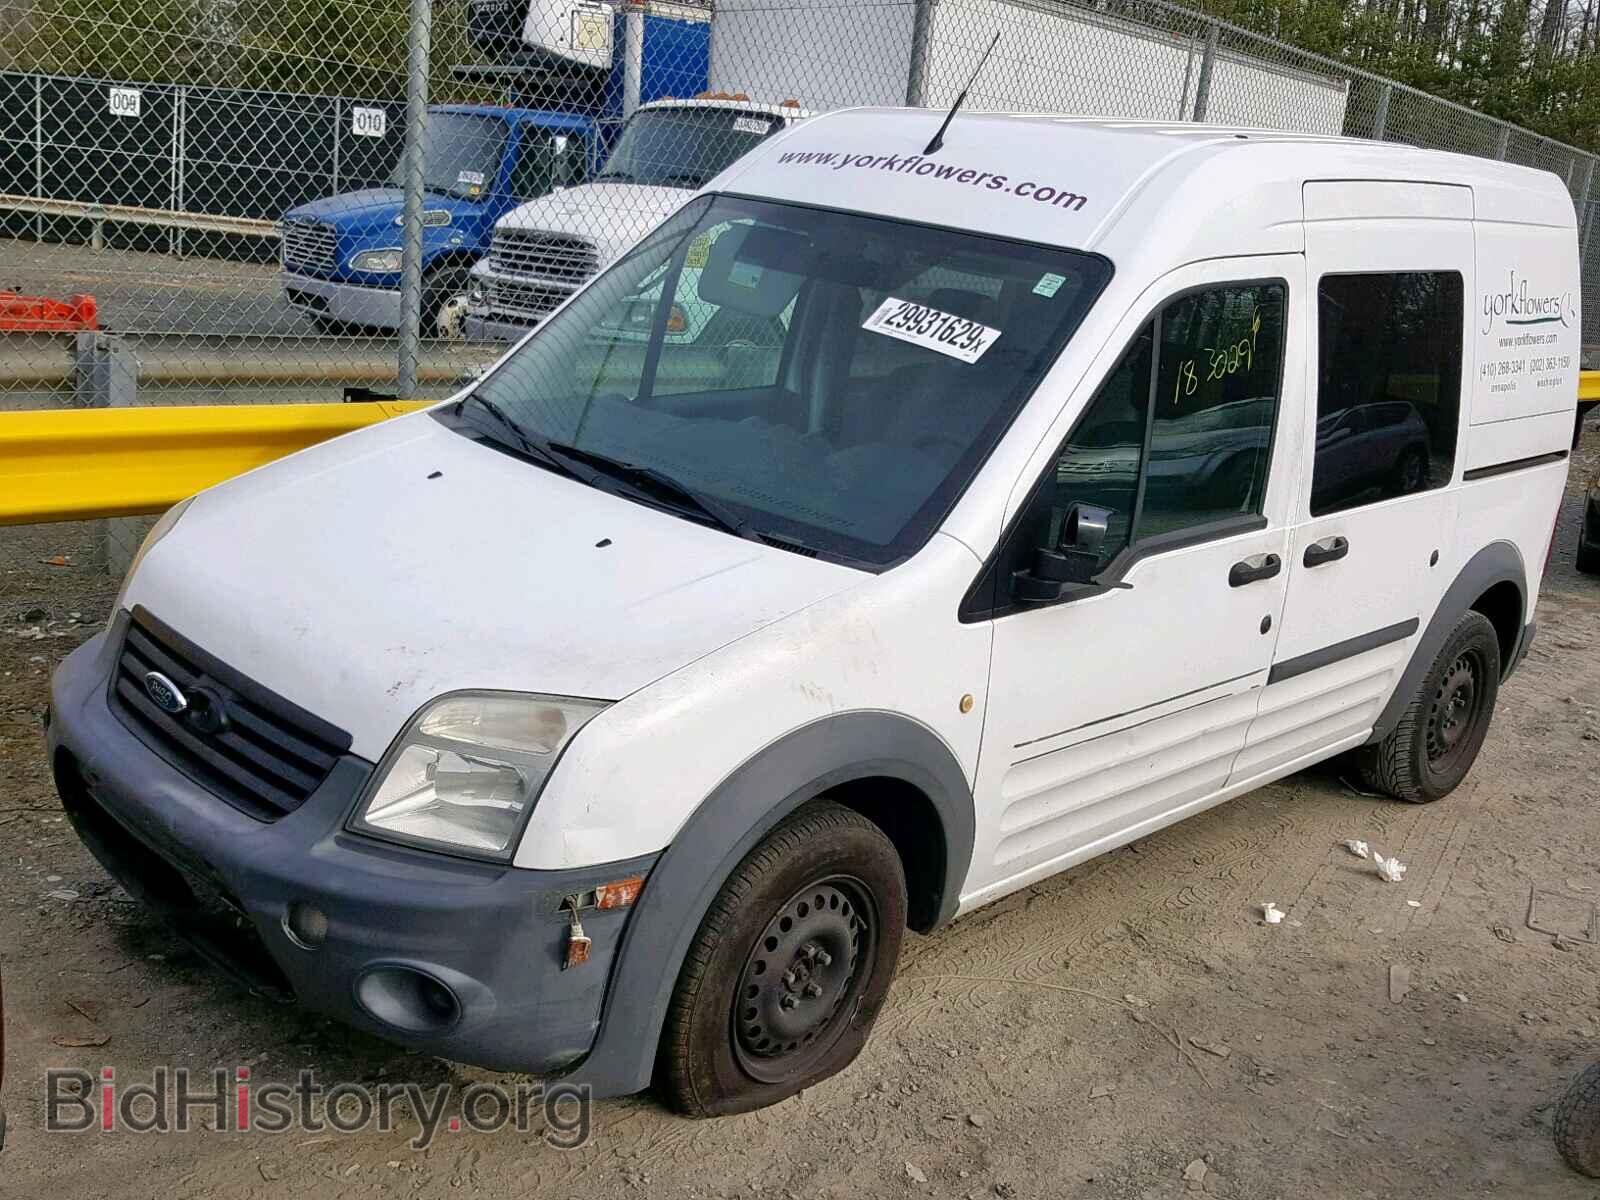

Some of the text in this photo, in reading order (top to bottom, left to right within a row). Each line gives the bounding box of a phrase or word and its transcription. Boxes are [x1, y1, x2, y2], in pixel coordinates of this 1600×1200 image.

[357, 112, 382, 131] 010
[777, 150, 1088, 212] www.yorkflowers.com
[1481, 270, 1560, 336] yorkflowers
[1498, 333, 1558, 350] www.yorkflowers.com
[1174, 359, 1198, 405] 18
